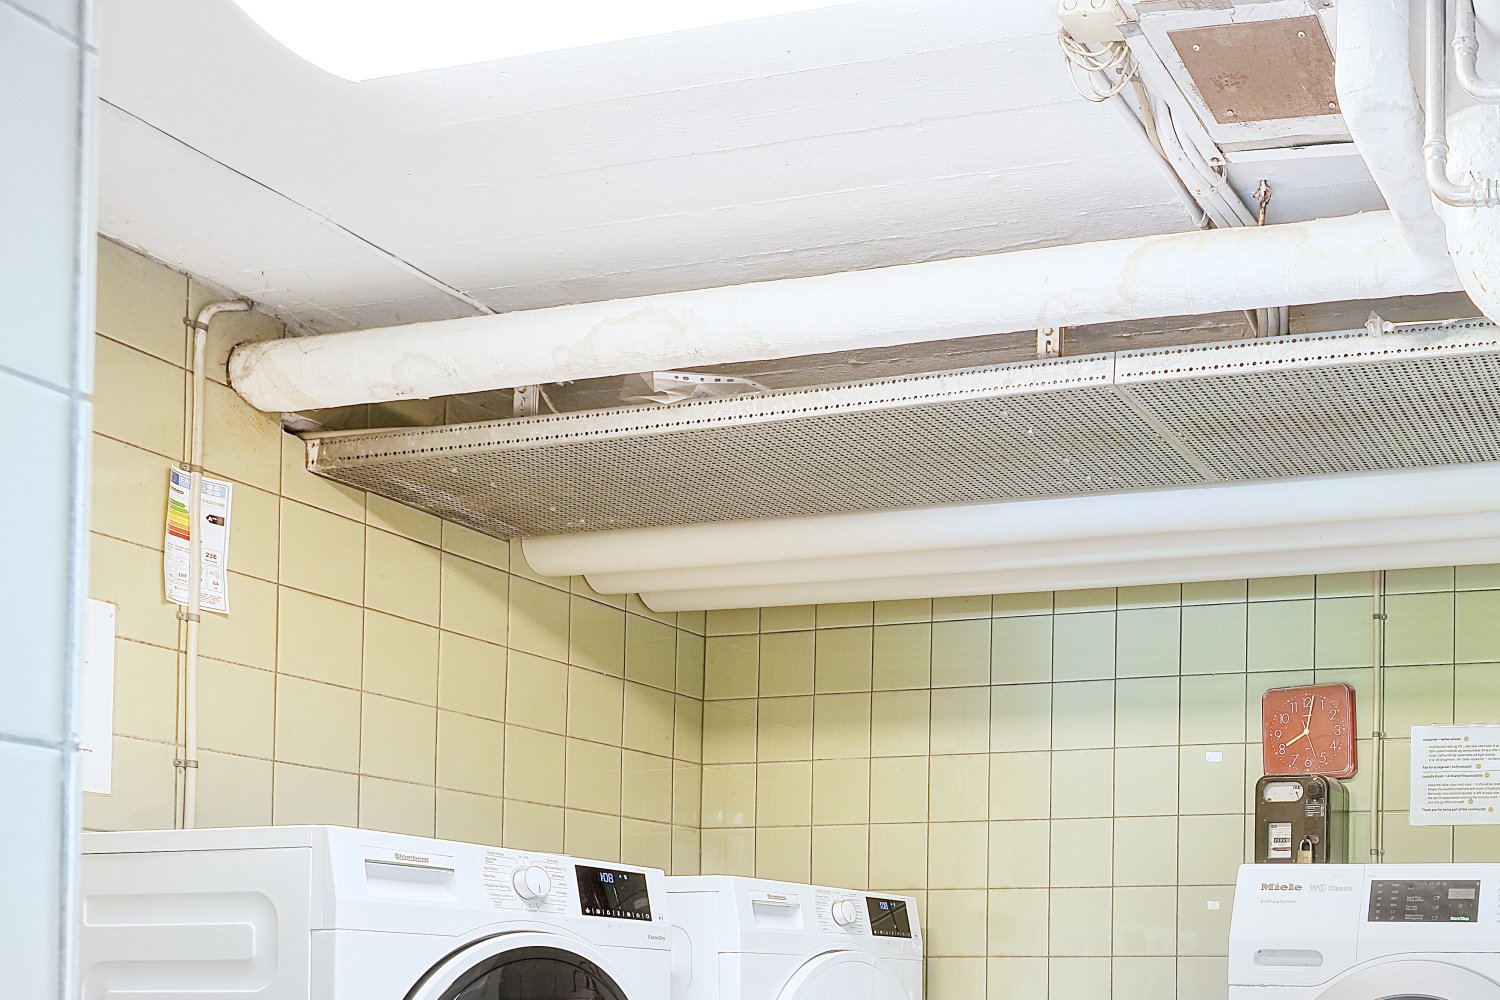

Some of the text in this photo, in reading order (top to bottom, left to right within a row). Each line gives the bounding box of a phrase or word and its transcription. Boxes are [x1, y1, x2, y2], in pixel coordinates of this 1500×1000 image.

[1290, 702, 1298, 713] 11
[1320, 700, 1324, 710] 1
[1280, 712, 1290, 724] 10
[1330, 709, 1336, 720] 2
[1274, 730, 1282, 740] 9
[1334, 724, 1341, 736] 3
[1278, 744, 1286, 754] 8
[1330, 740, 1337, 750] 4
[1291, 754, 1300, 766] 7
[1304, 756, 1312, 768] 6
[1320, 752, 1326, 764] 5
[395, 852, 429, 863] Blomberg
